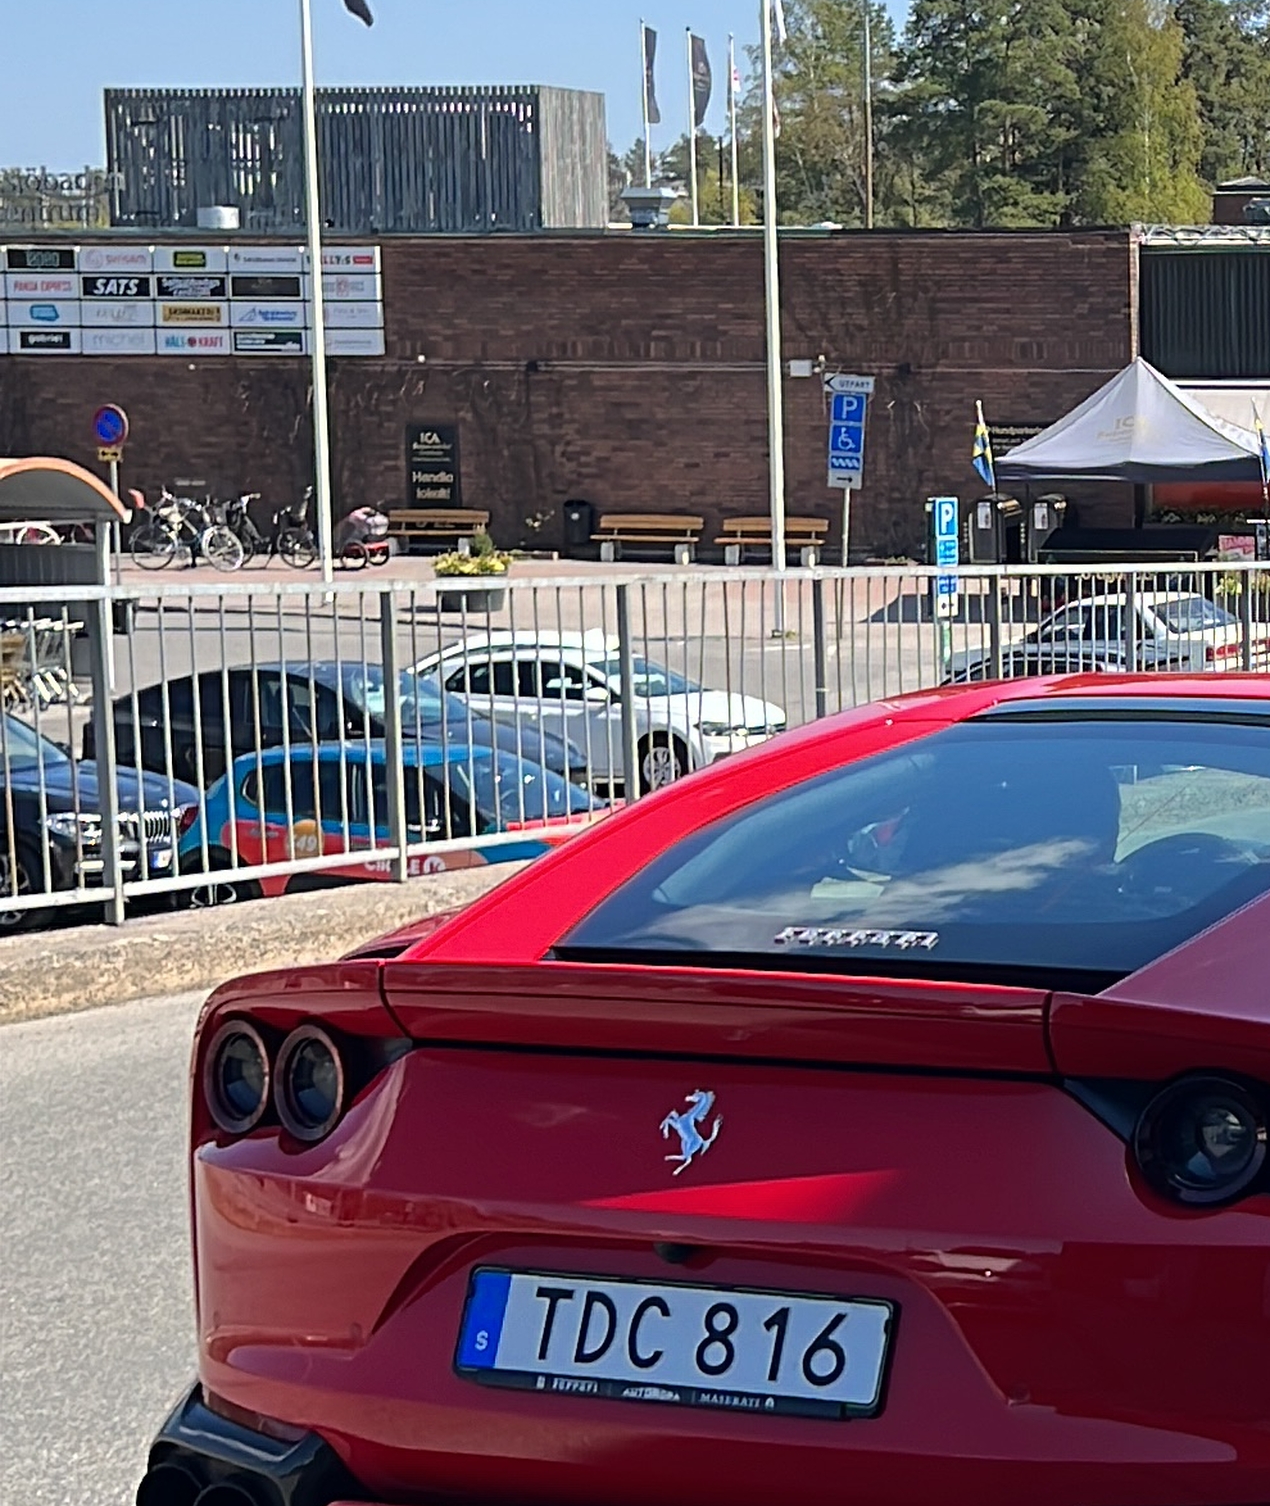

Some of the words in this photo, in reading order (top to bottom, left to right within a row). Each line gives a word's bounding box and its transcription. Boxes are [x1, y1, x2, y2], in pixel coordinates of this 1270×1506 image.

[93, 278, 140, 295] SATS
[840, 380, 870, 389] UTFART
[842, 396, 858, 419] P
[420, 432, 441, 443] ICA
[412, 471, 453, 483] Handla
[941, 503, 954, 534] P
[474, 1330, 488, 1350] S
[535, 1287, 671, 1369] TDC
[695, 1302, 848, 1387] 816
[701, 1392, 760, 1409] MASERATI
